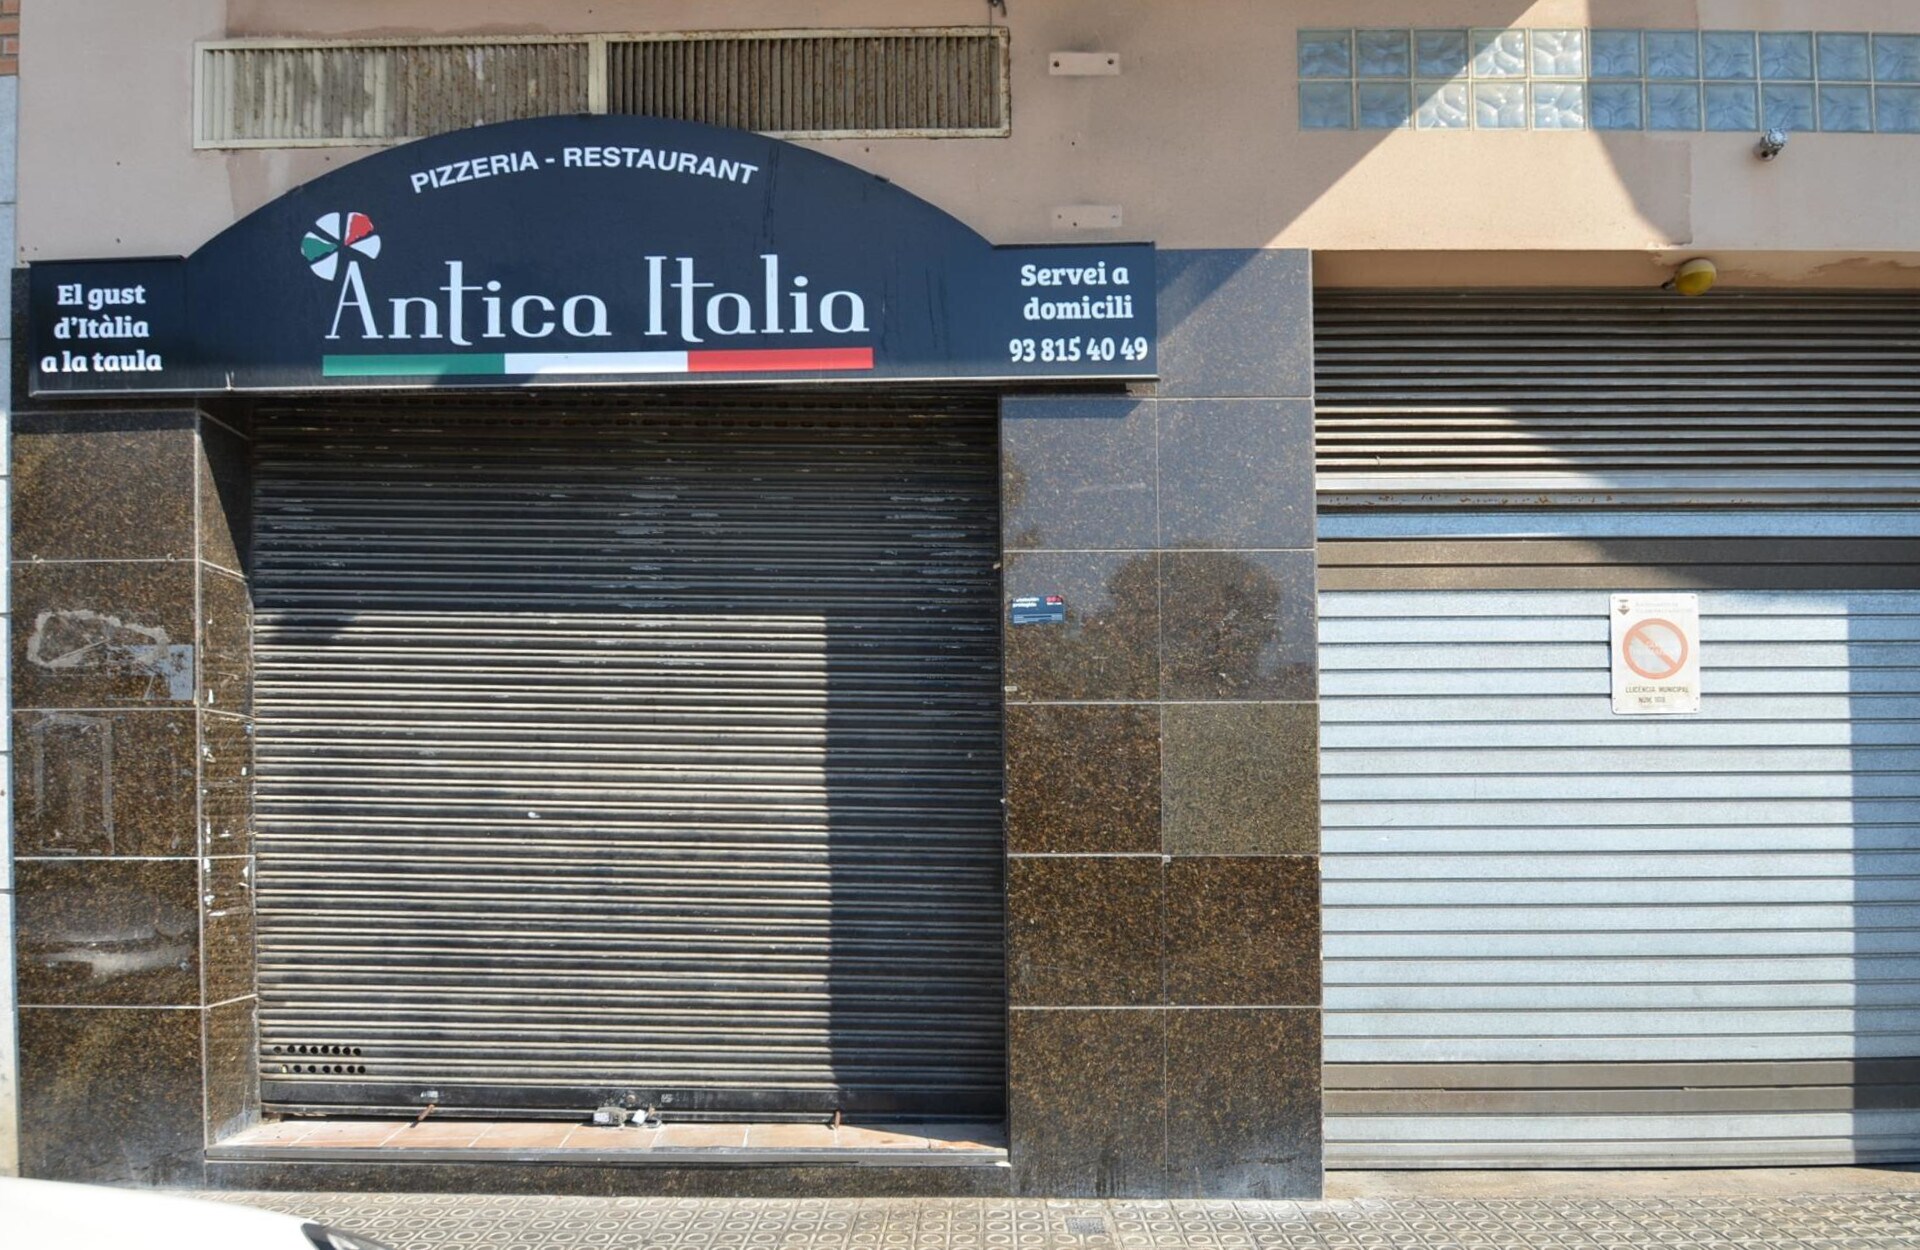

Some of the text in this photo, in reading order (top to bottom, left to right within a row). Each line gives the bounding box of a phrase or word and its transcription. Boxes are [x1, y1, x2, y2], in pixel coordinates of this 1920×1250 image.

[411, 151, 539, 193] PIZZERIA
[564, 146, 759, 186] RESTAURANT
[1021, 261, 1129, 286] Servei a
[57, 283, 146, 310] El gust
[325, 254, 870, 346] Antica Italia
[1023, 295, 1134, 320] domicili
[41, 349, 163, 373] a la taula
[1009, 336, 1148, 363] 93 815 40 49
